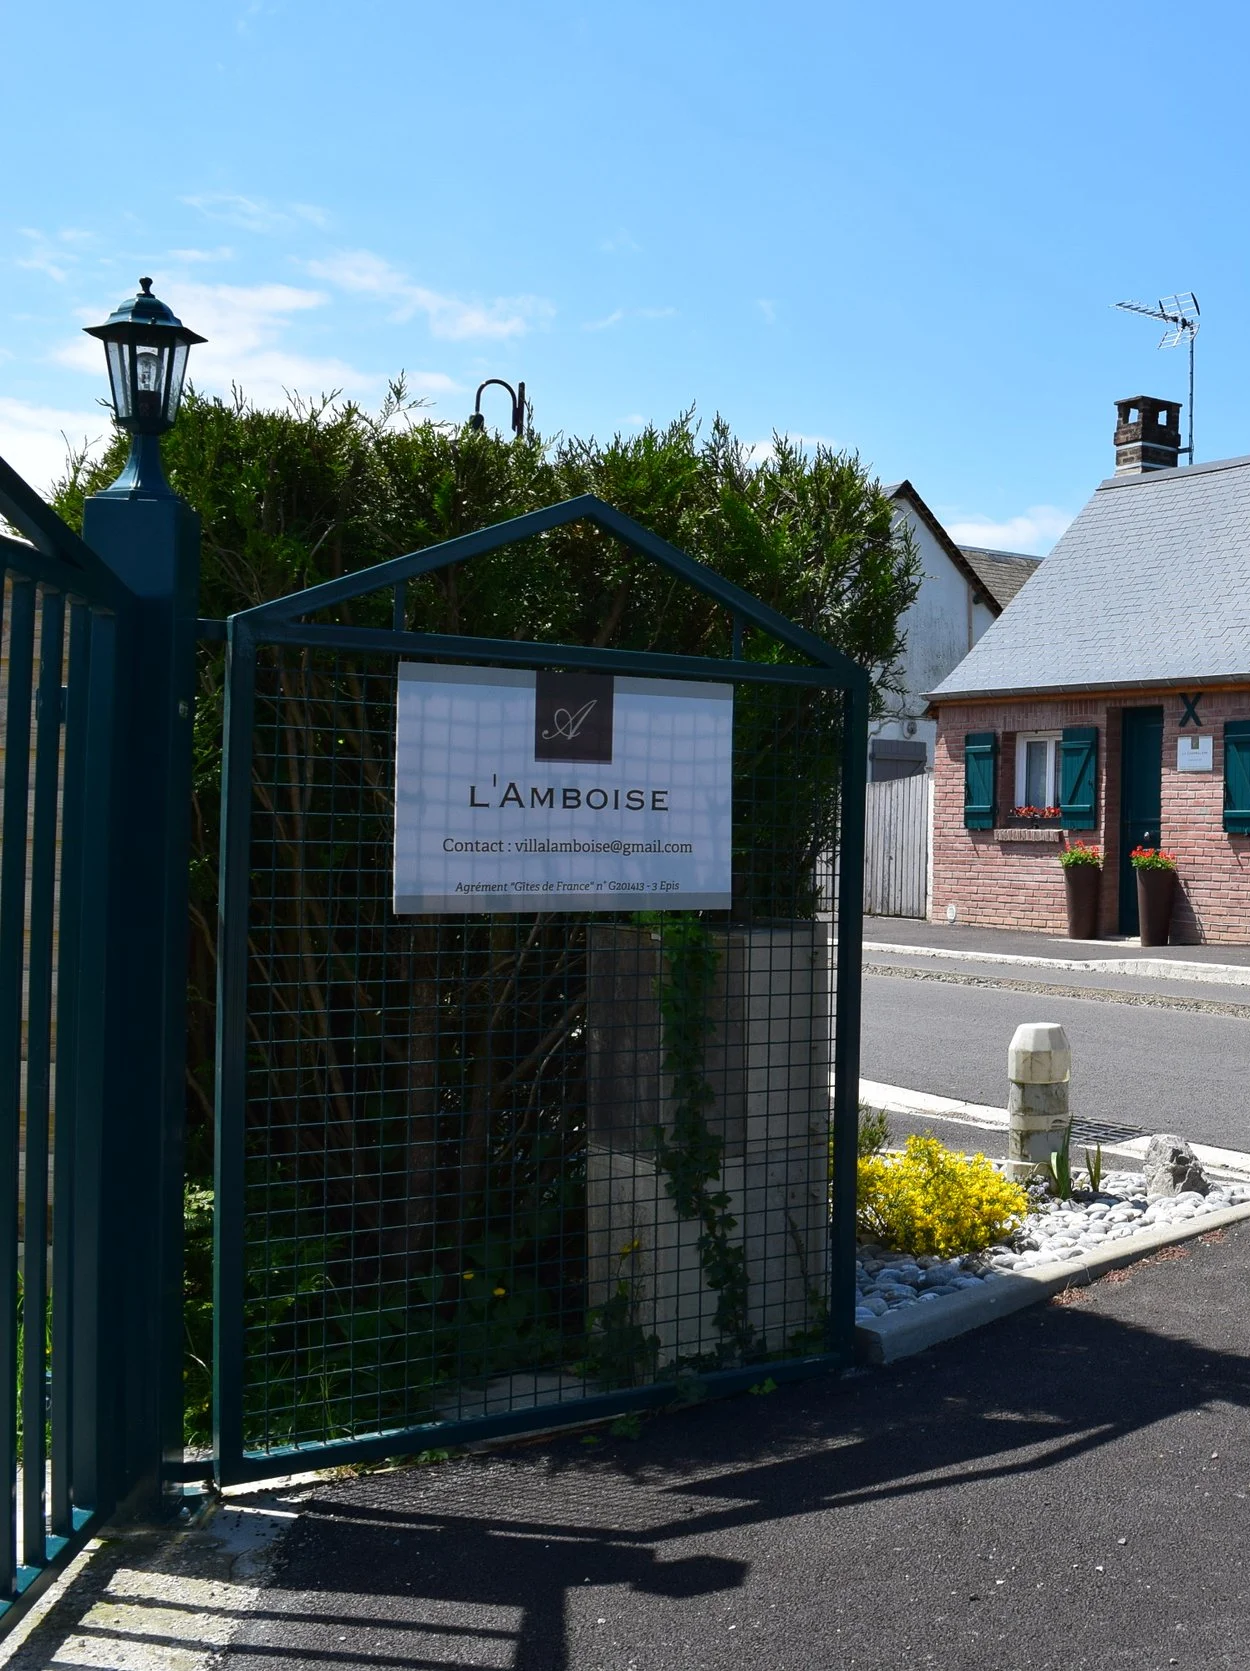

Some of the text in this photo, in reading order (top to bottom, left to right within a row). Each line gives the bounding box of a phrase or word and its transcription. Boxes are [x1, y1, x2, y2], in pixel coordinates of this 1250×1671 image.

[541, 699, 598, 740] A
[469, 773, 669, 811] L'AMBOISE
[442, 838, 504, 852] Contact
[515, 838, 693, 856] villalamboise@gmail.com
[455, 881, 508, 894] Agrément
[541, 881, 554, 891] de
[651, 882, 657, 891] 3
[659, 880, 680, 892] Epis
